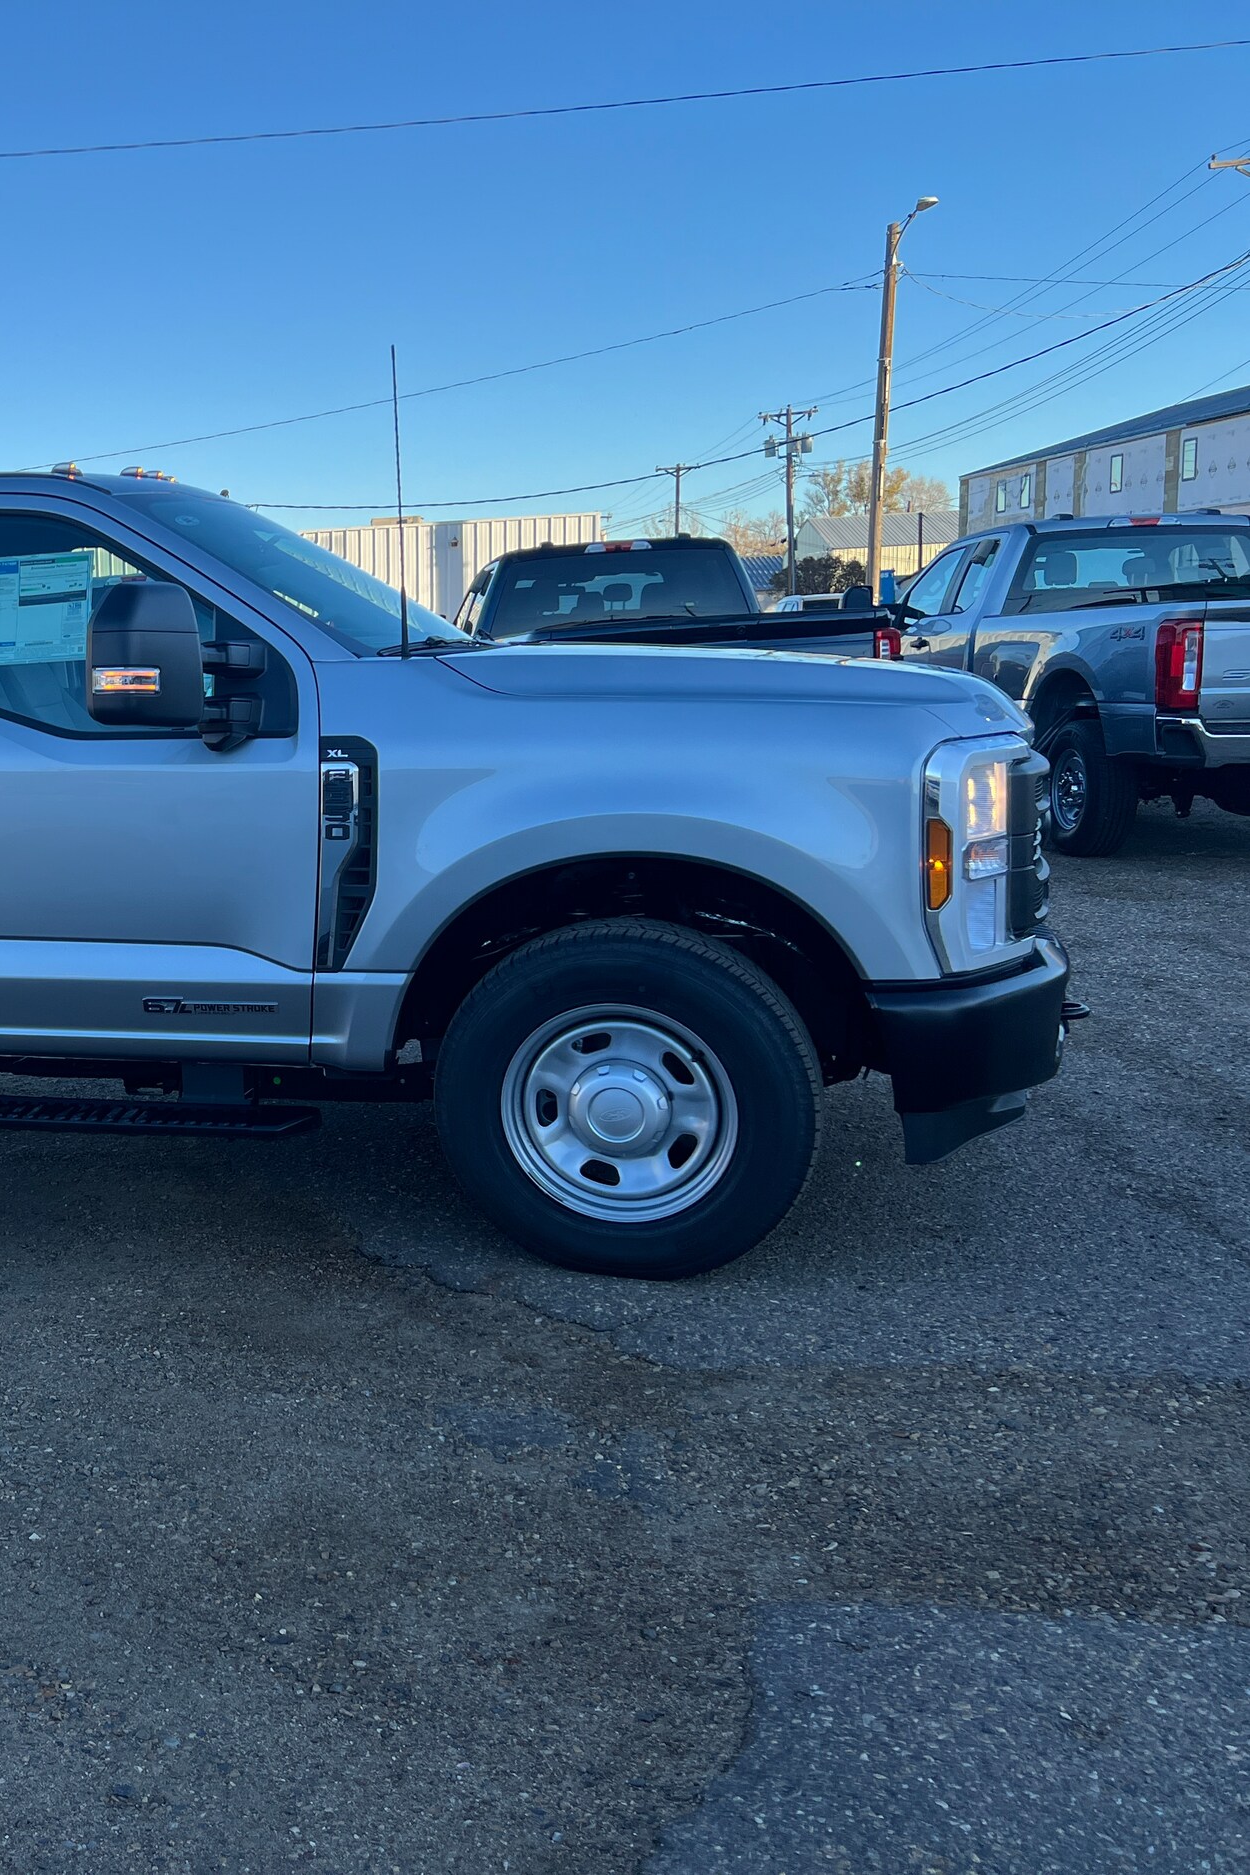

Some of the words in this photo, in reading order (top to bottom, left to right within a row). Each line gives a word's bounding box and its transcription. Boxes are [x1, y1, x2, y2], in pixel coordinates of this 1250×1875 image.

[1110, 626, 1146, 641] 4x4
[326, 749, 349, 758] XL
[193, 1004, 230, 1012] POWER
[233, 1004, 276, 1013] STROKE
